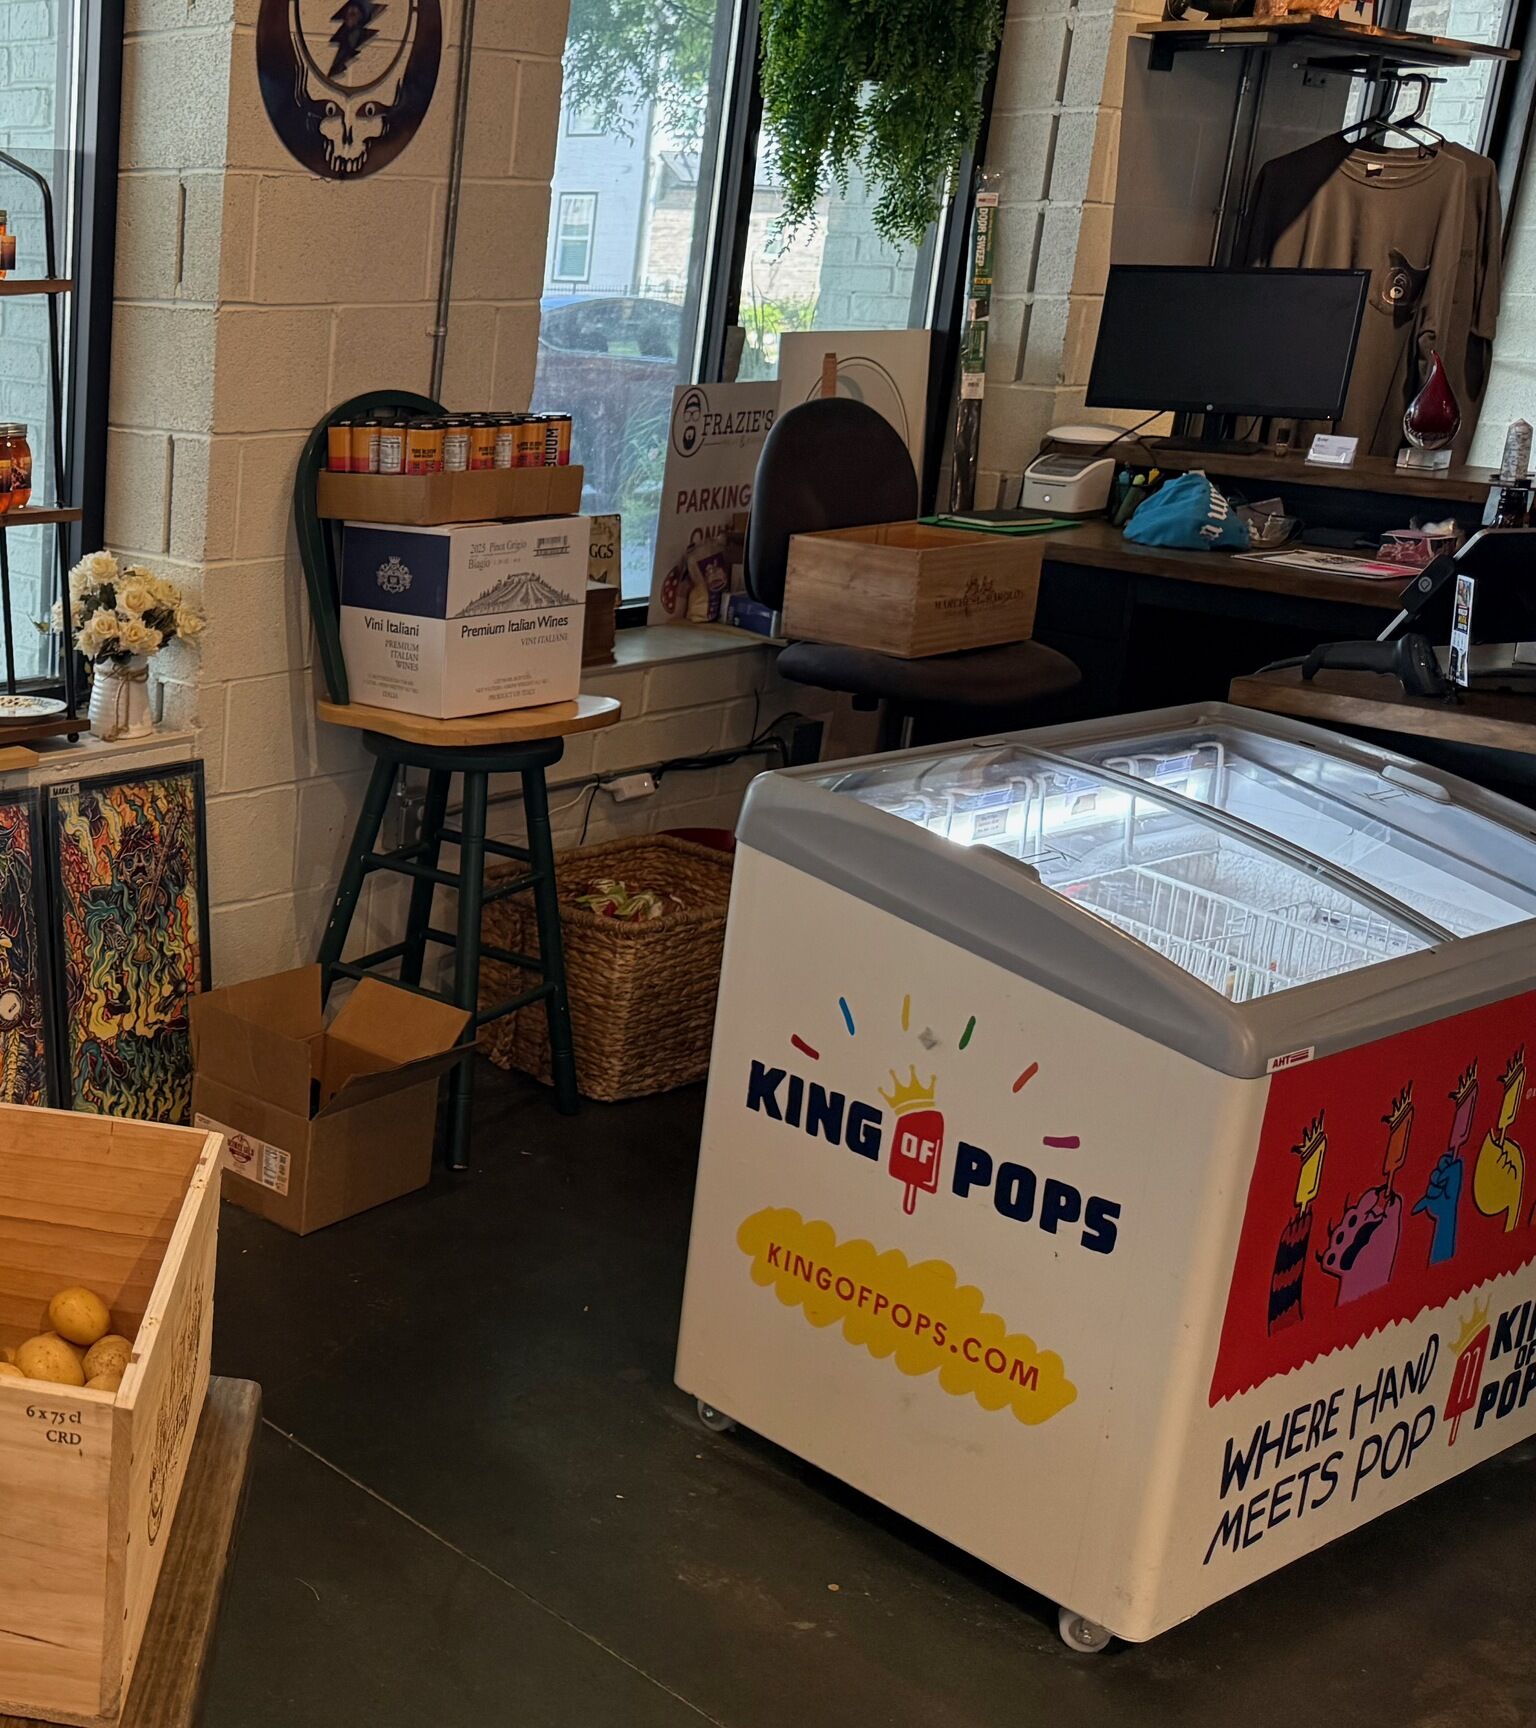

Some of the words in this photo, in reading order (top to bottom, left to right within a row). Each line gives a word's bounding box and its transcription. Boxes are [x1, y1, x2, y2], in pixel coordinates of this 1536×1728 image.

[977, 207, 989, 233] DOOR
[975, 234, 987, 267] SWEEP
[701, 409, 775, 437] FRAZIE'S
[675, 483, 753, 515] PARKING
[364, 615, 384, 632] Vini
[386, 619, 420, 637] Italiani
[461, 623, 506, 639] Premium
[507, 618, 536, 633] Italian
[537, 615, 569, 628] Wines
[384, 639, 419, 652] PREMIUM
[520, 637, 537, 646] VINI
[537, 633, 569, 645] ITALIANI
[390, 649, 419, 662] ITALIAN
[395, 660, 419, 672] WINES
[1272, 1055, 1291, 1069] AHT
[746, 1059, 883, 1161] KING
[900, 1131, 936, 1165] OF
[952, 1140, 1122, 1255] POPS
[767, 1241, 1040, 1392] KINGOFPOPS.COM
[26, 1405, 36, 1418] 6
[38, 1409, 48, 1420] x
[51, 1411, 66, 1425] 75
[69, 1410, 82, 1425] cl
[1220, 1388, 1345, 1500] WHERE
[1349, 1333, 1440, 1441] HAND
[46, 1429, 82, 1446] CRD
[1203, 1451, 1344, 1566] MEETS
[1351, 1404, 1436, 1503] POP
